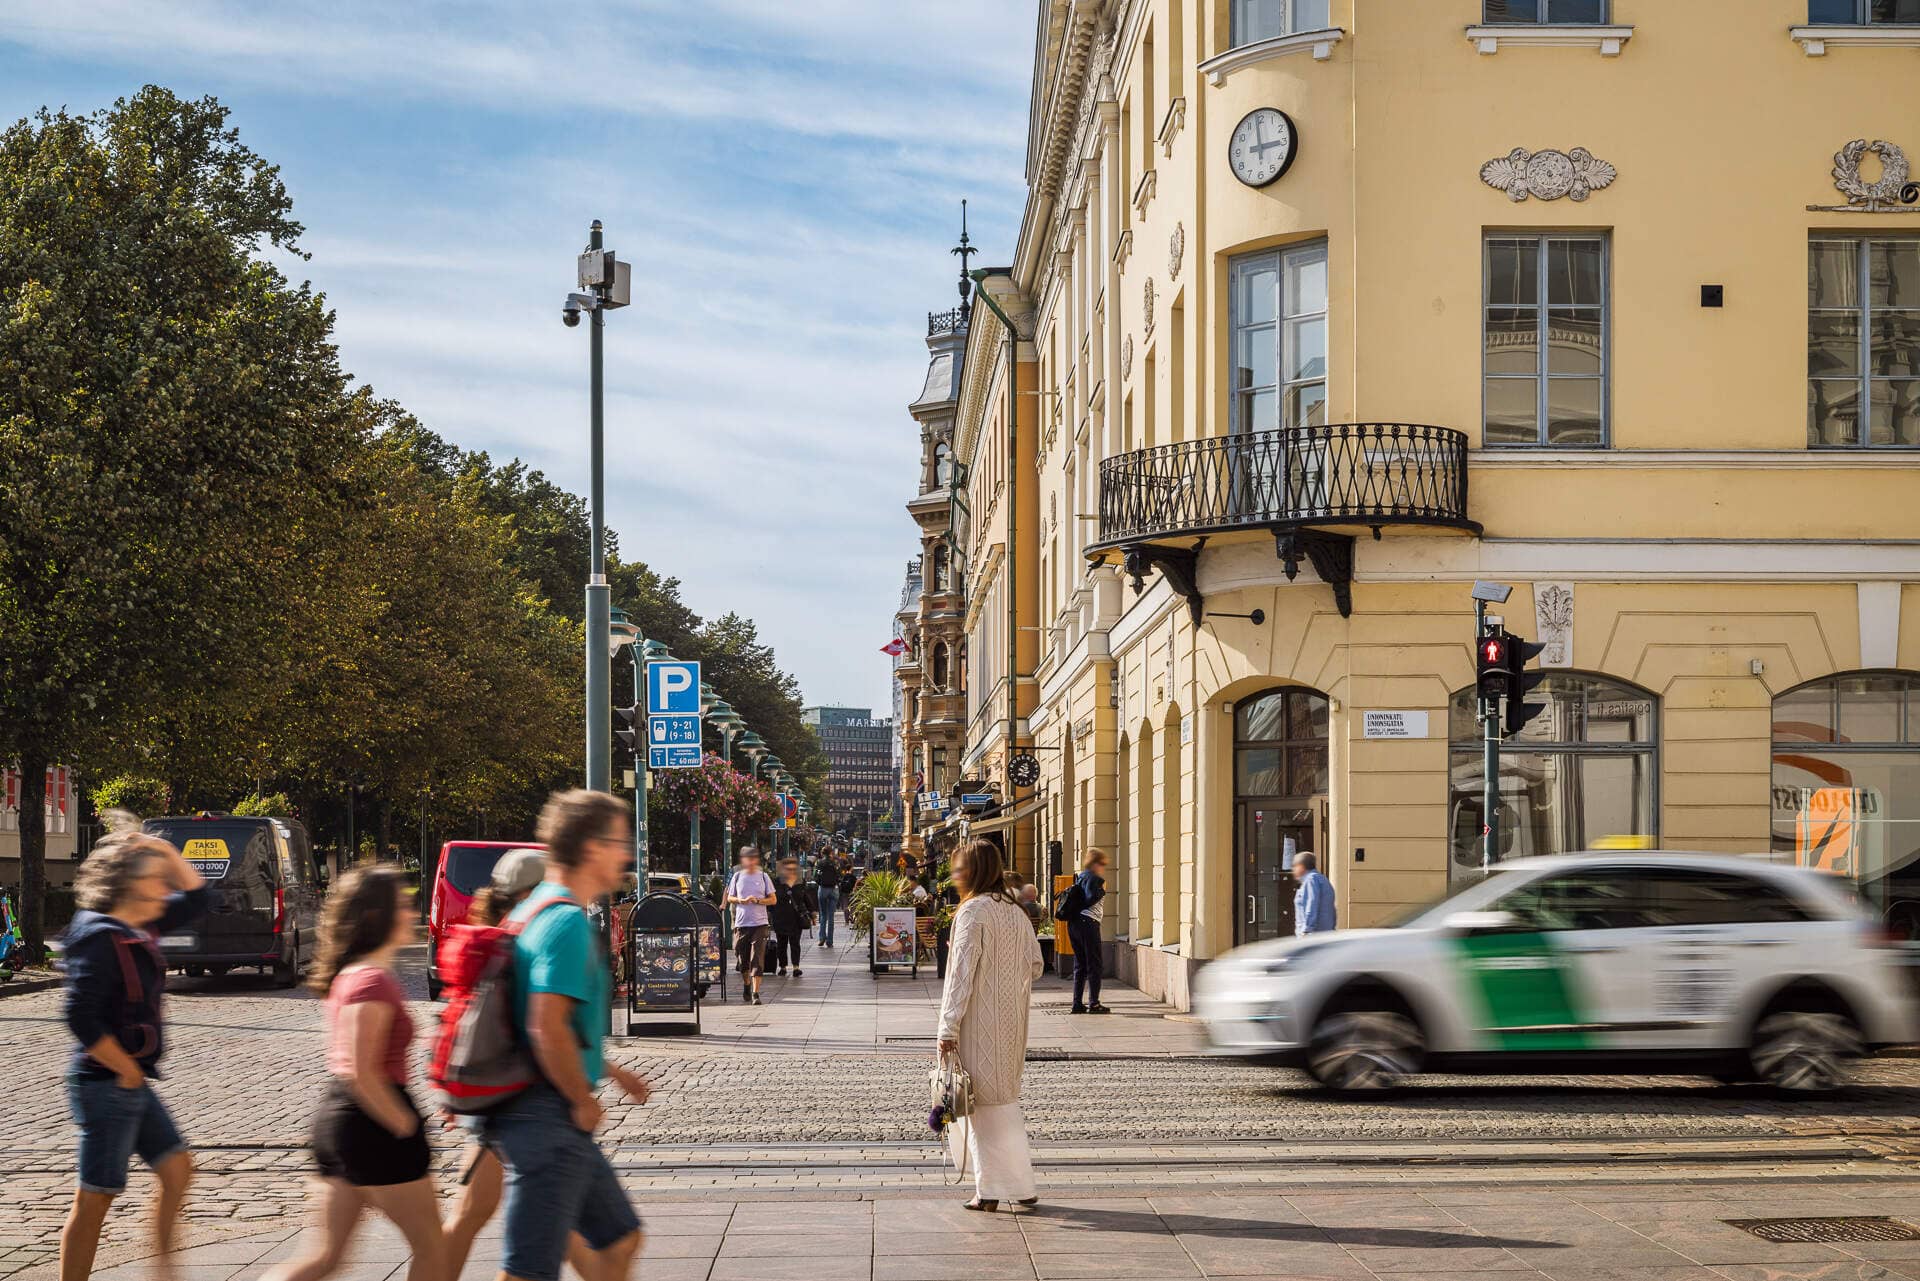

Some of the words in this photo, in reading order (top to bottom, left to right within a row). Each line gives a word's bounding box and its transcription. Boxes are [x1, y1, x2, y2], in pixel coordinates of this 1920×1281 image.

[1247, 122, 1252, 131] 11
[1278, 124, 1284, 134] 2
[1280, 137, 1288, 146] 3
[1235, 148, 1241, 158] 9
[1277, 152, 1284, 160] 4
[1238, 161, 1245, 171] 8
[1269, 164, 1276, 174] 5
[1247, 169, 1253, 179] 7
[1257, 171, 1265, 180] 6
[659, 666, 693, 710] P
[1367, 713, 1404, 721] UNIONINKATU
[656, 756, 661, 765] 1
[194, 841, 218, 849] TAKSI
[189, 849, 222, 857] HELSINKI
